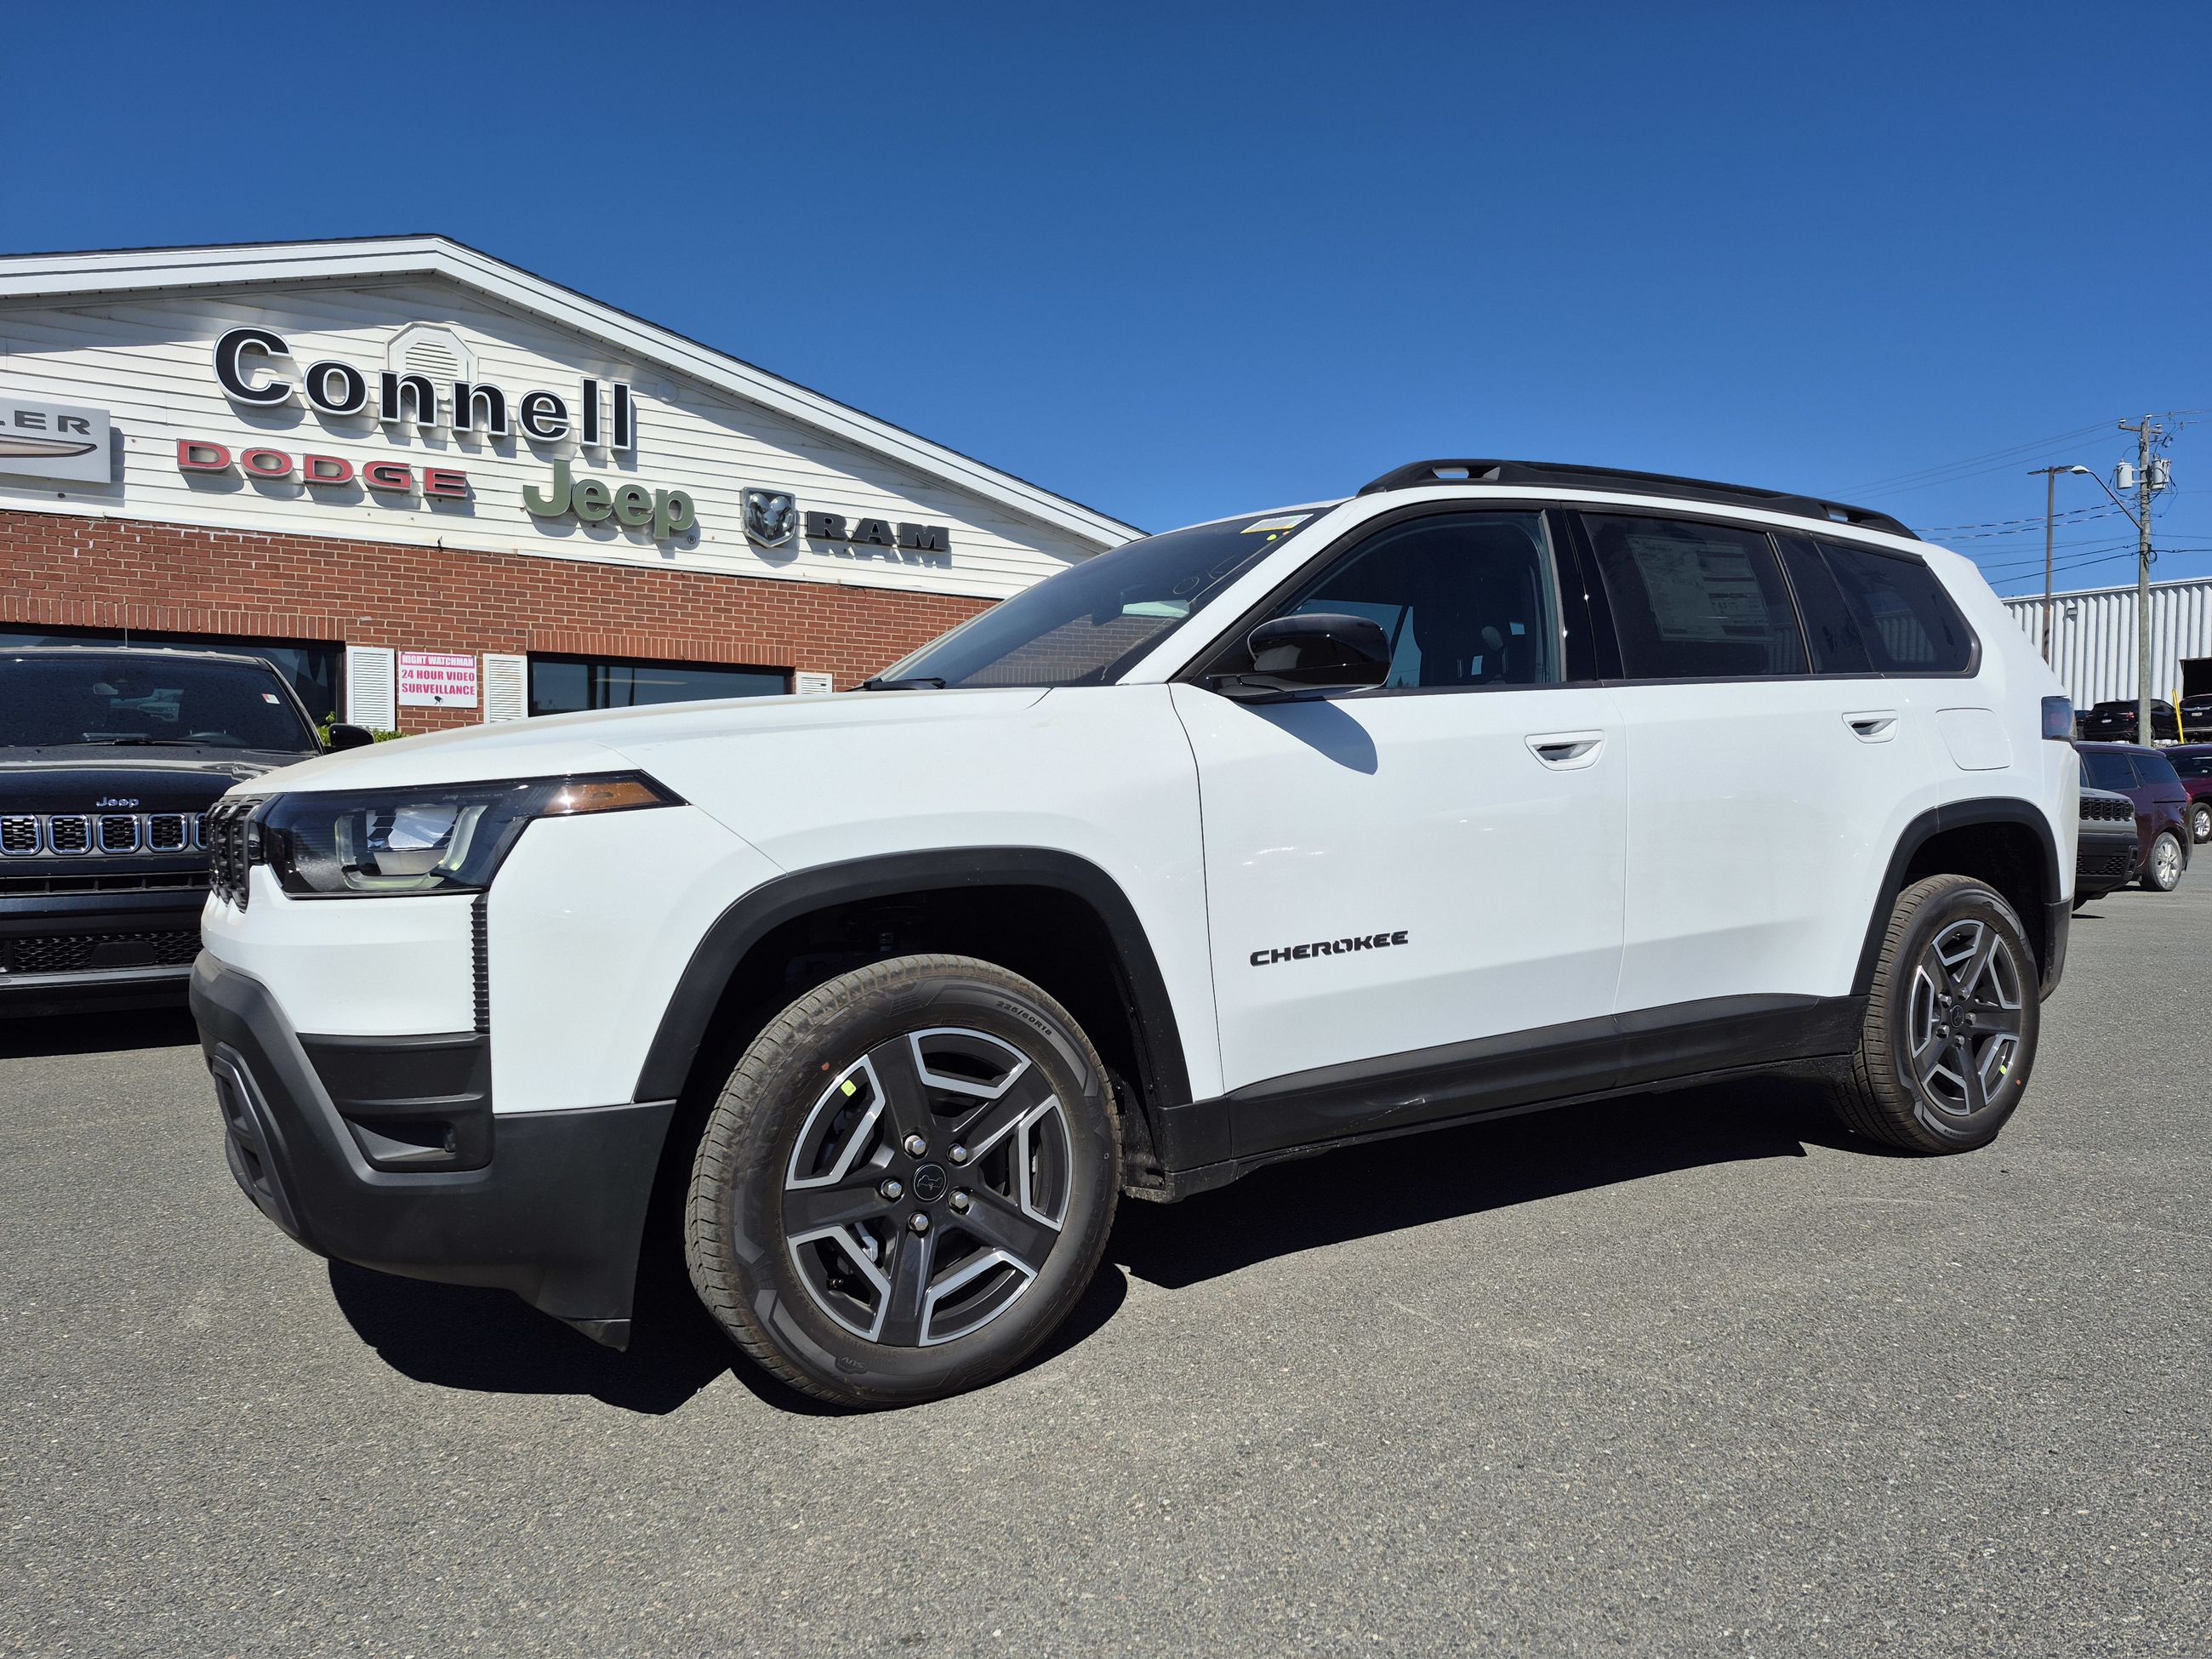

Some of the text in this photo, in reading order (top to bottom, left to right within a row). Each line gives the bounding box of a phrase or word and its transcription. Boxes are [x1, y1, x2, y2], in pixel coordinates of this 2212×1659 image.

[212, 326, 632, 451] Connell
[0, 409, 92, 436] ER
[176, 438, 468, 498] DODGE
[522, 459, 696, 540] Jeep
[806, 510, 950, 552] RAM
[402, 653, 474, 667] NIGHT WATCHMAN
[402, 670, 476, 681] 24 HOUR VIDEO
[402, 682, 476, 695] SURVEILLANCE
[95, 796, 140, 807] Jeep
[1250, 931, 1409, 967] CHEROKEE
[995, 1001, 1052, 1035] 225/60R18
